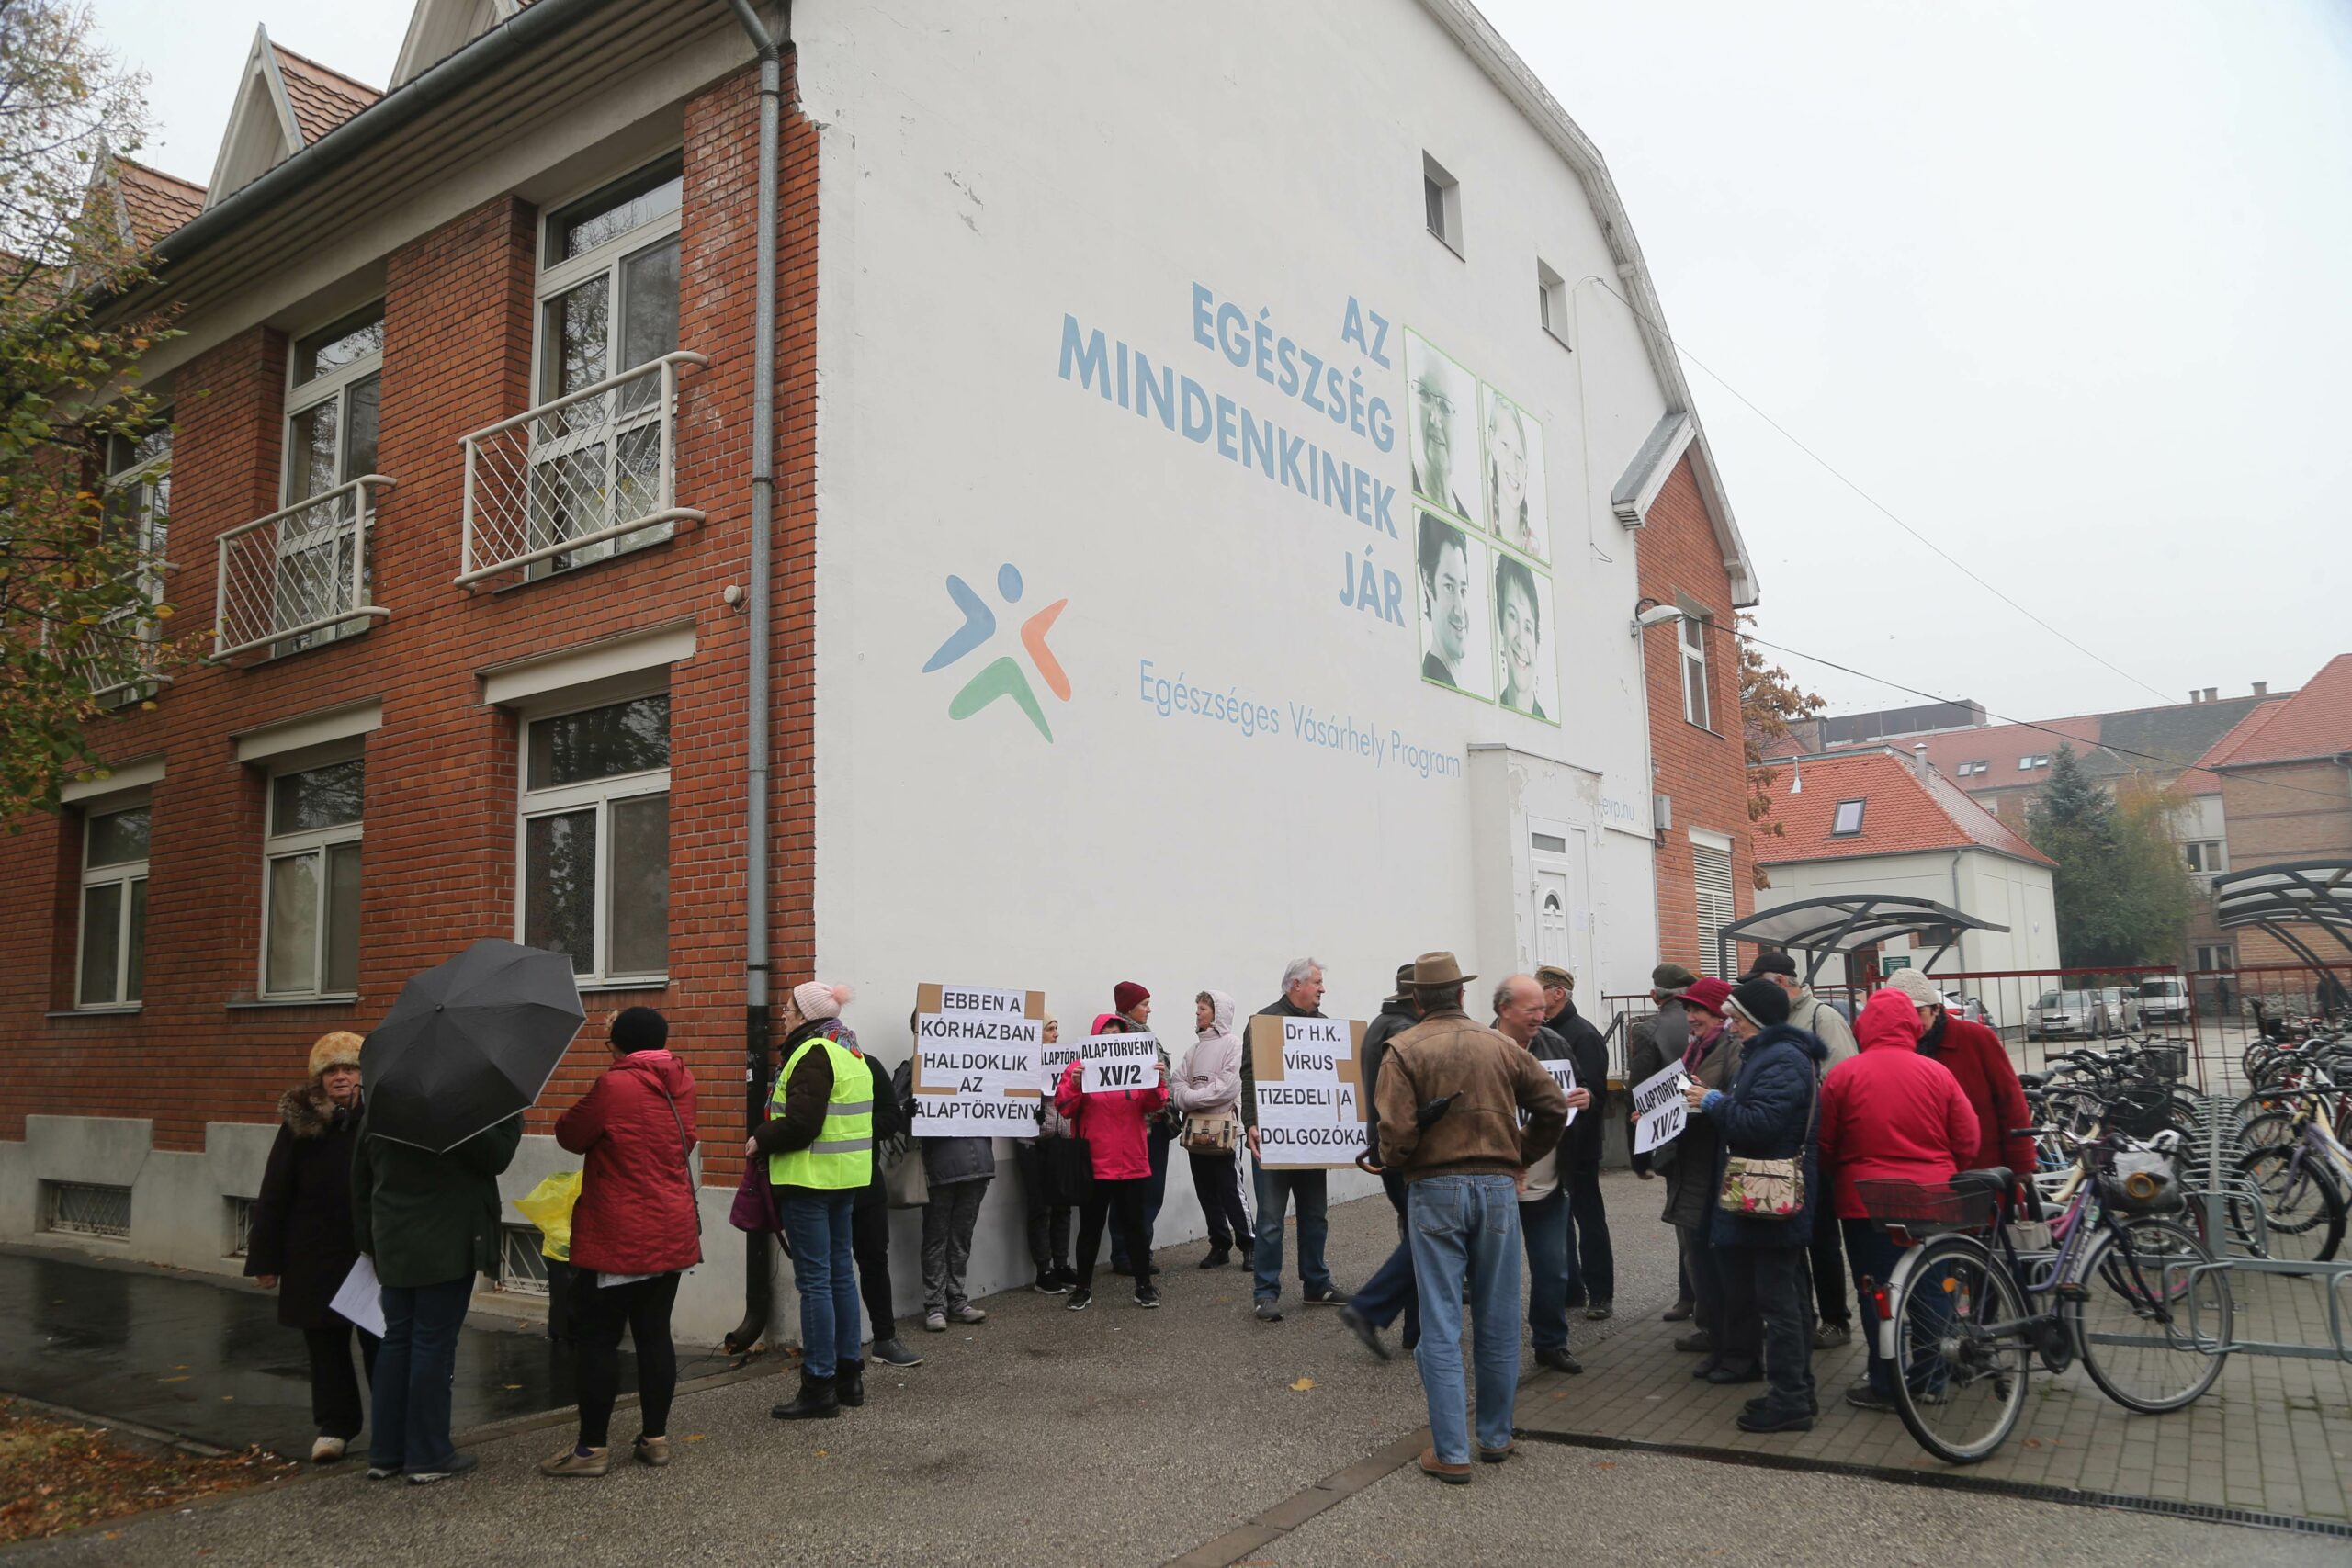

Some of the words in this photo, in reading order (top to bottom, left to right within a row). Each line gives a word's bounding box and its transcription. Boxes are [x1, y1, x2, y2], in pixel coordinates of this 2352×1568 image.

[1341, 295, 1391, 370] AZ
[1192, 280, 1395, 454] EGÉSZSÉG
[1057, 312, 1399, 541] MINDENKINEK
[1339, 543, 1406, 628] JÁR
[1140, 659, 1280, 738] Egészséges
[1288, 701, 1385, 769] Vásárhely
[1391, 729, 1461, 779] Program
[944, 992, 1004, 1011] EBBEN
[1009, 997, 1022, 1012] A
[921, 1017, 1035, 1042] KÓRHÁZBAN
[1285, 1023, 1304, 1040] Dr
[1309, 1025, 1340, 1042] H.K.
[1081, 1038, 1154, 1060] ALAPTÖRVÉNY
[923, 1052, 1028, 1071] HALDOKLIK
[1284, 1050, 1334, 1071] VÍRUS
[959, 1077, 983, 1093] AZ
[1099, 1065, 1142, 1087] XV/2
[1258, 1088, 1330, 1105] TIZEDELI
[1341, 1089, 1352, 1106] A
[1635, 1069, 1686, 1115] ALAPTÖRVÉ
[915, 1100, 1040, 1120] ALAPTÖRVÉNY
[1261, 1125, 1369, 1145] DOLGOZÓKA
[1650, 1106, 1679, 1144] XV/2
